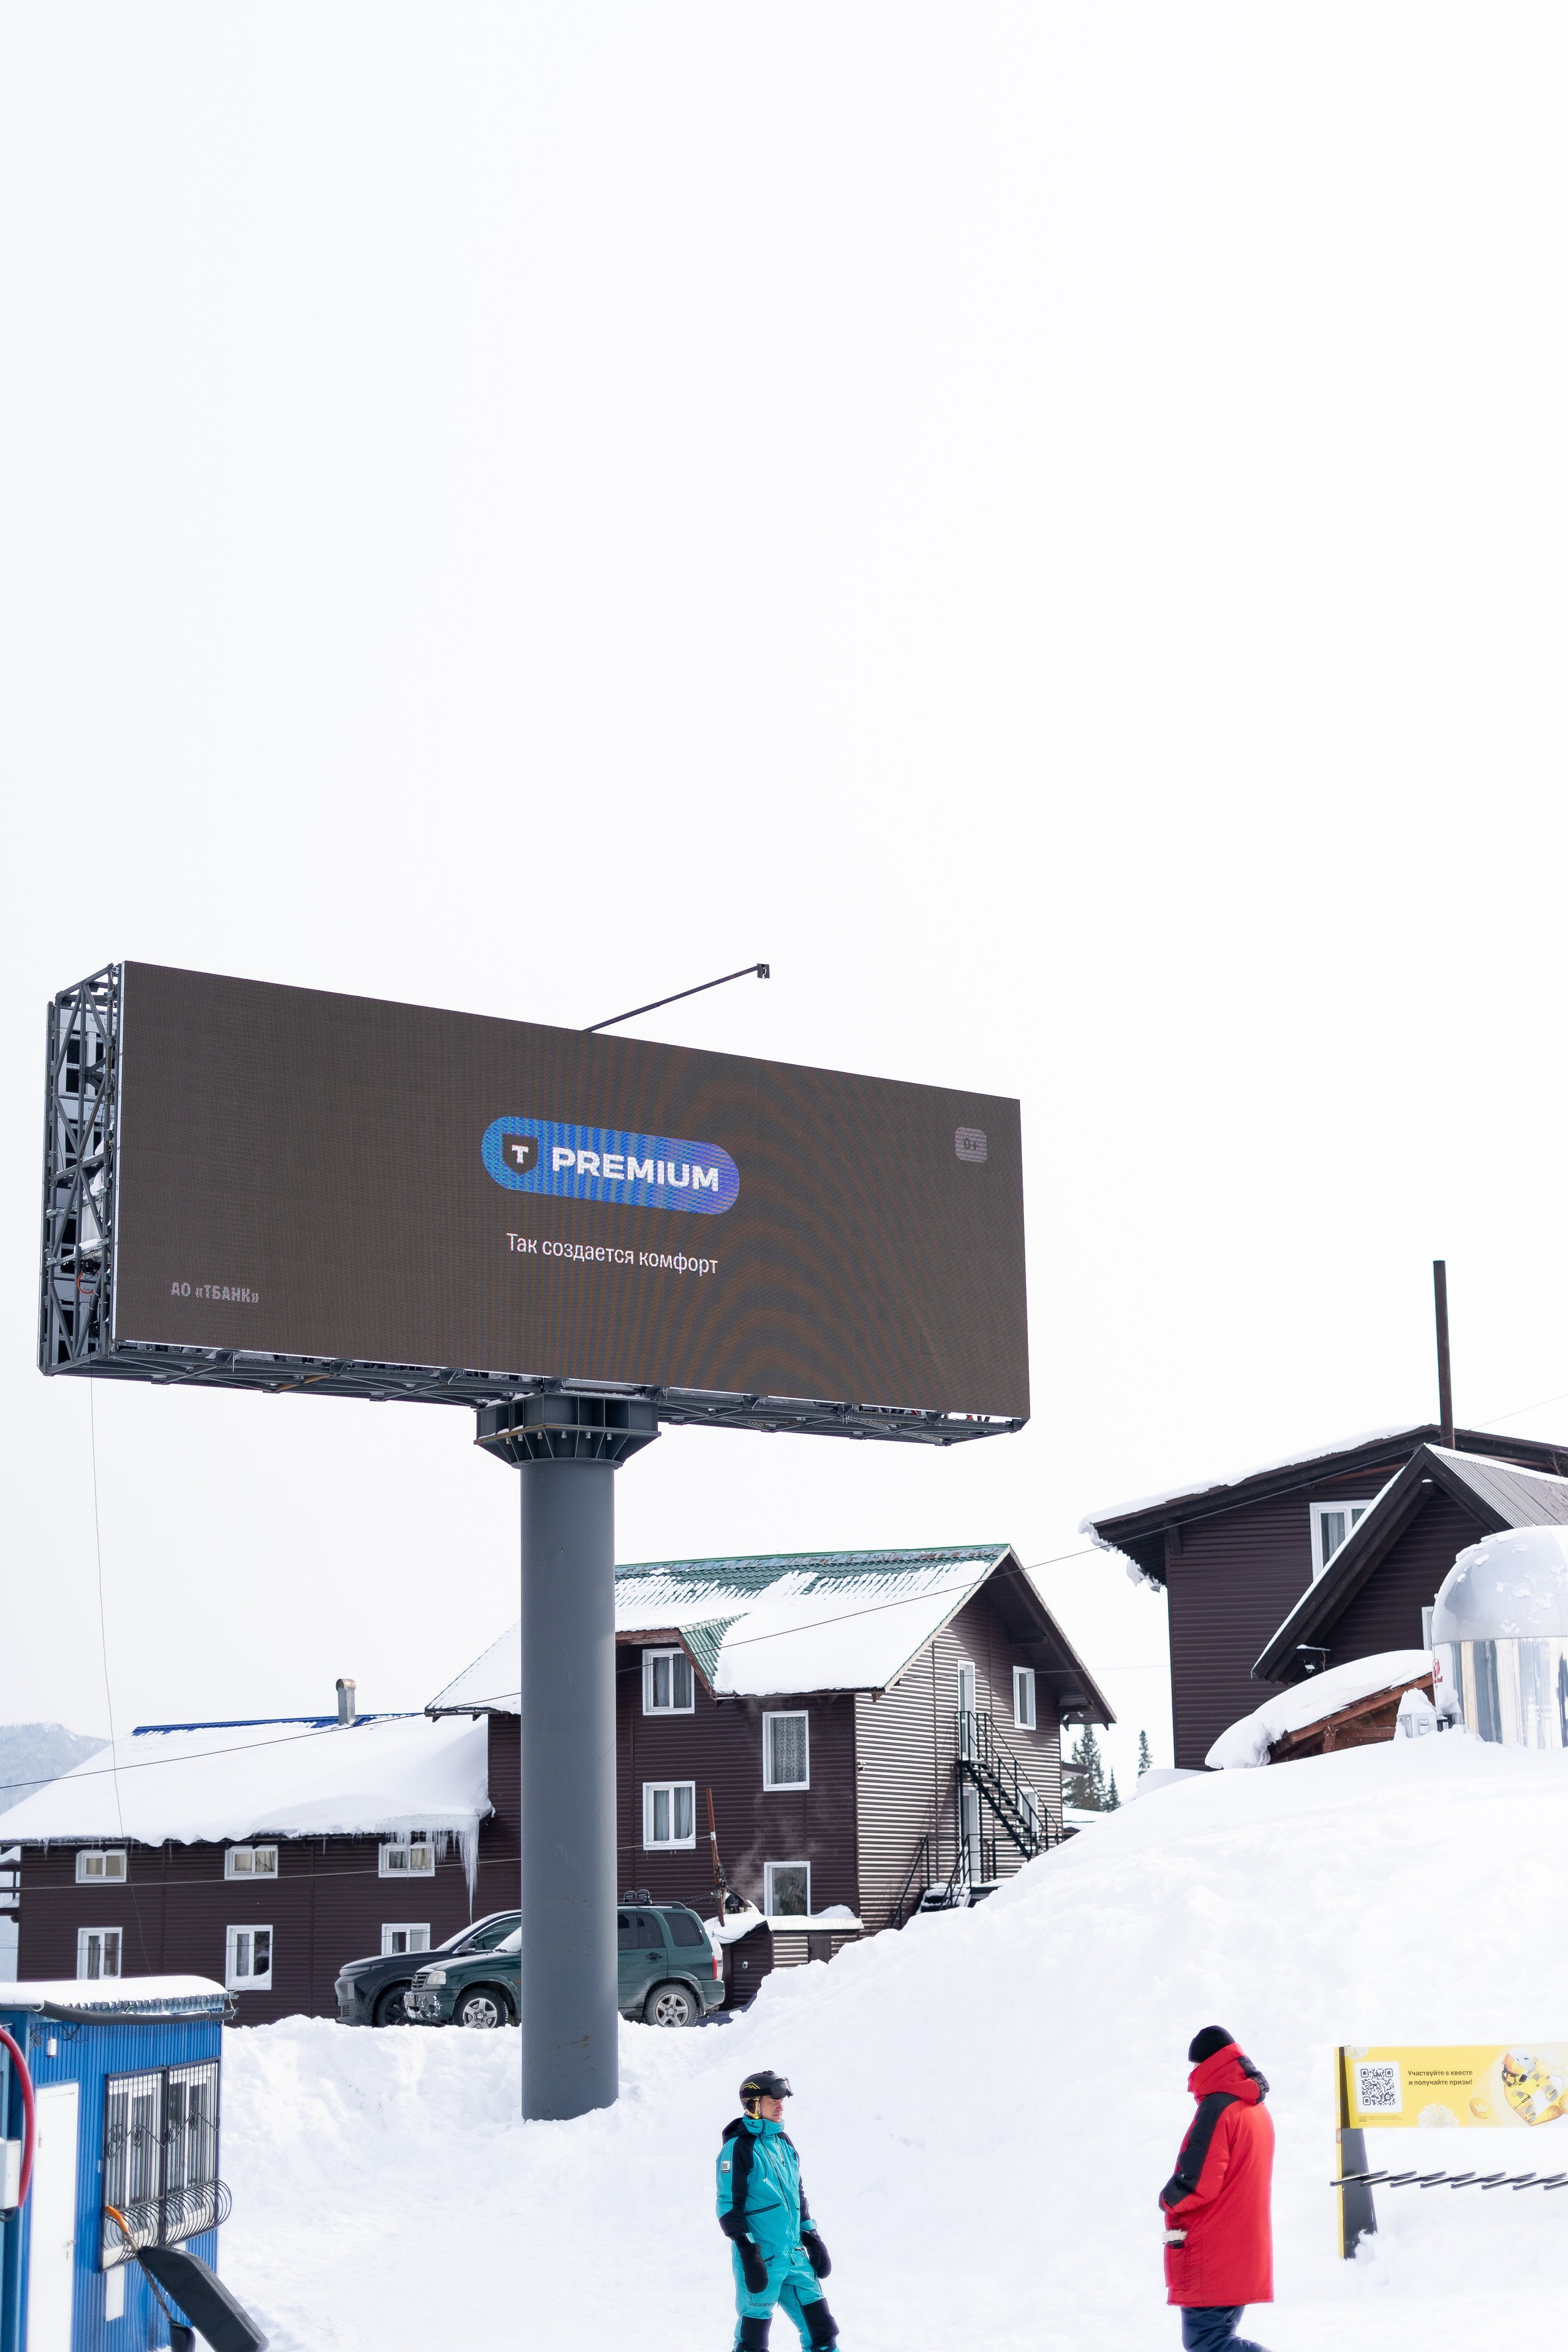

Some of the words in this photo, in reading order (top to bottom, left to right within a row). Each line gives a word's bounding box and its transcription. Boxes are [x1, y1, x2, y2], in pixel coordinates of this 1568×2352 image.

[552, 1146, 720, 1192] PREMIUM
[506, 1232, 538, 1254] Так
[541, 1240, 635, 1265] создается
[639, 1252, 719, 1277] комфорт
[171, 1281, 191, 1297] АО
